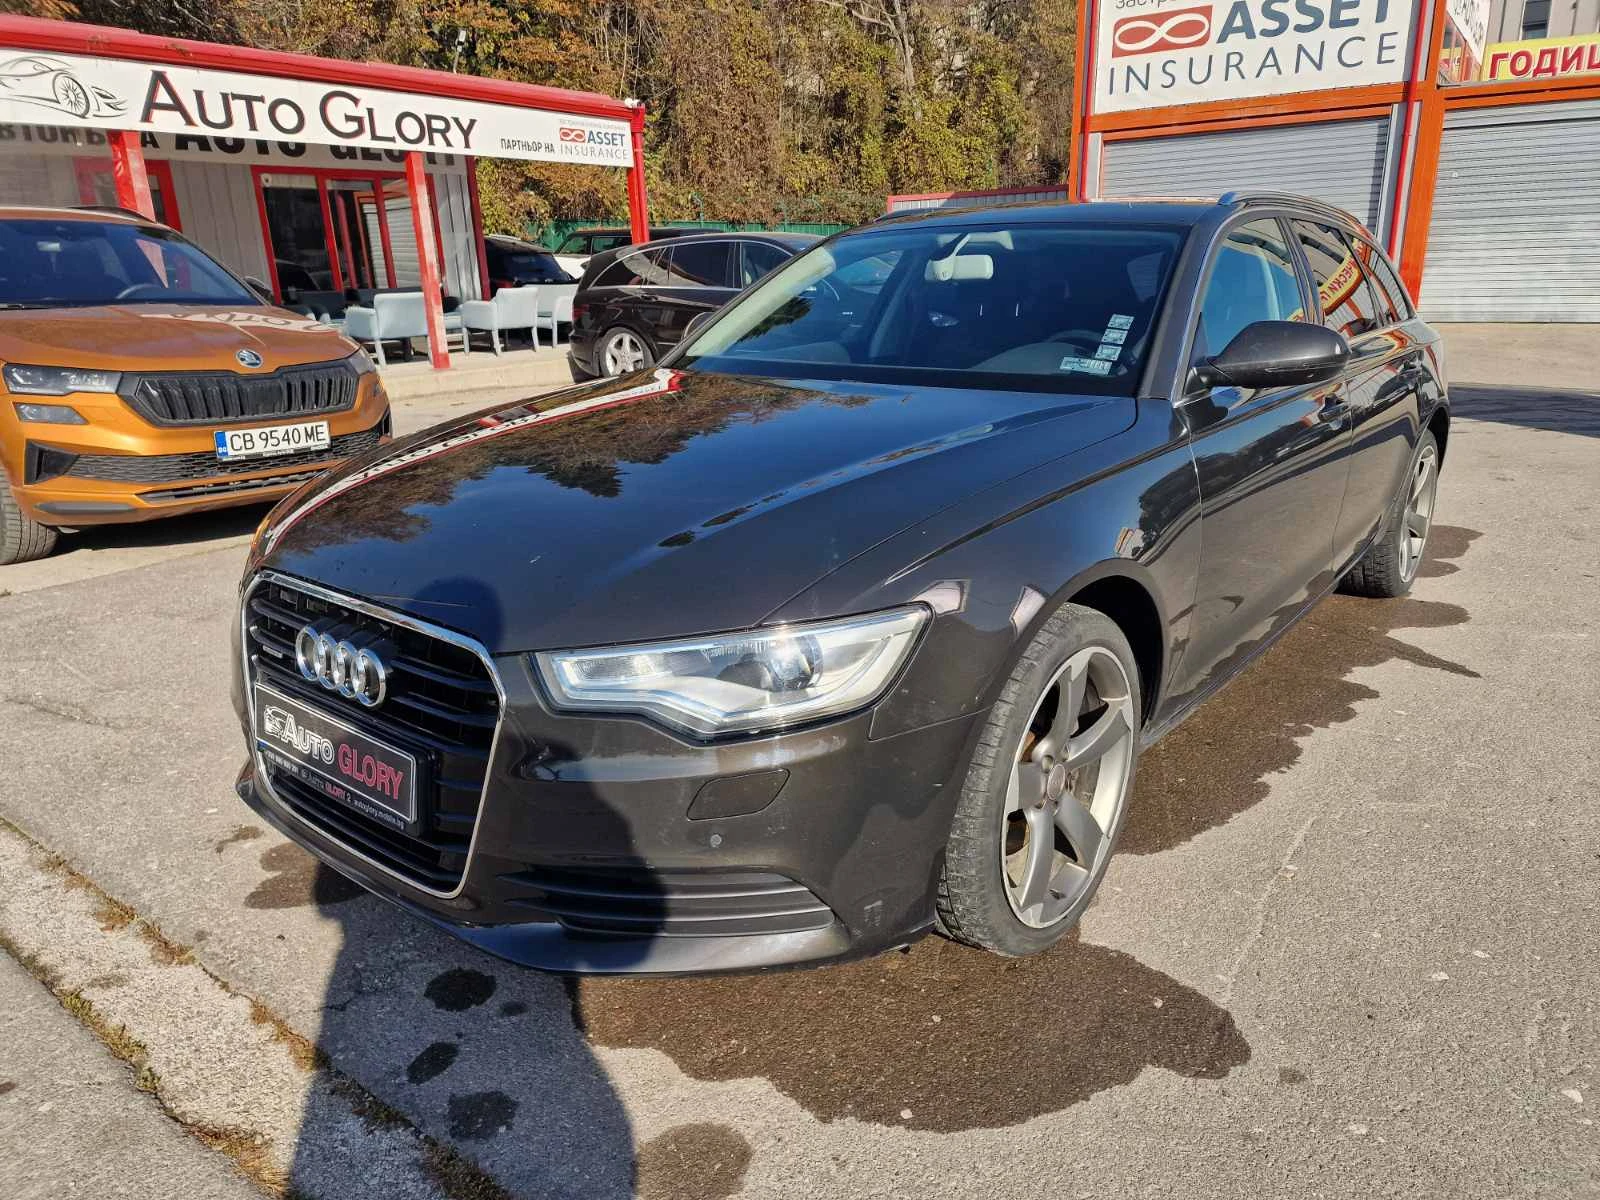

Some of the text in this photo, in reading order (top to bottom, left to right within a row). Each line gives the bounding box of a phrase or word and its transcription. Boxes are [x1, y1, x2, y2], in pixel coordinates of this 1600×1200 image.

[1108, 31, 1400, 95] INSURANCE
[140, 69, 477, 149] AUTO GLORY
[500, 138, 555, 154] ПАРТНЬОР НА
[560, 144, 629, 160] INSURANCE
[587, 130, 625, 147] ASSET
[230, 424, 326, 452] CB 9540 ME
[338, 743, 404, 800] GLORY
